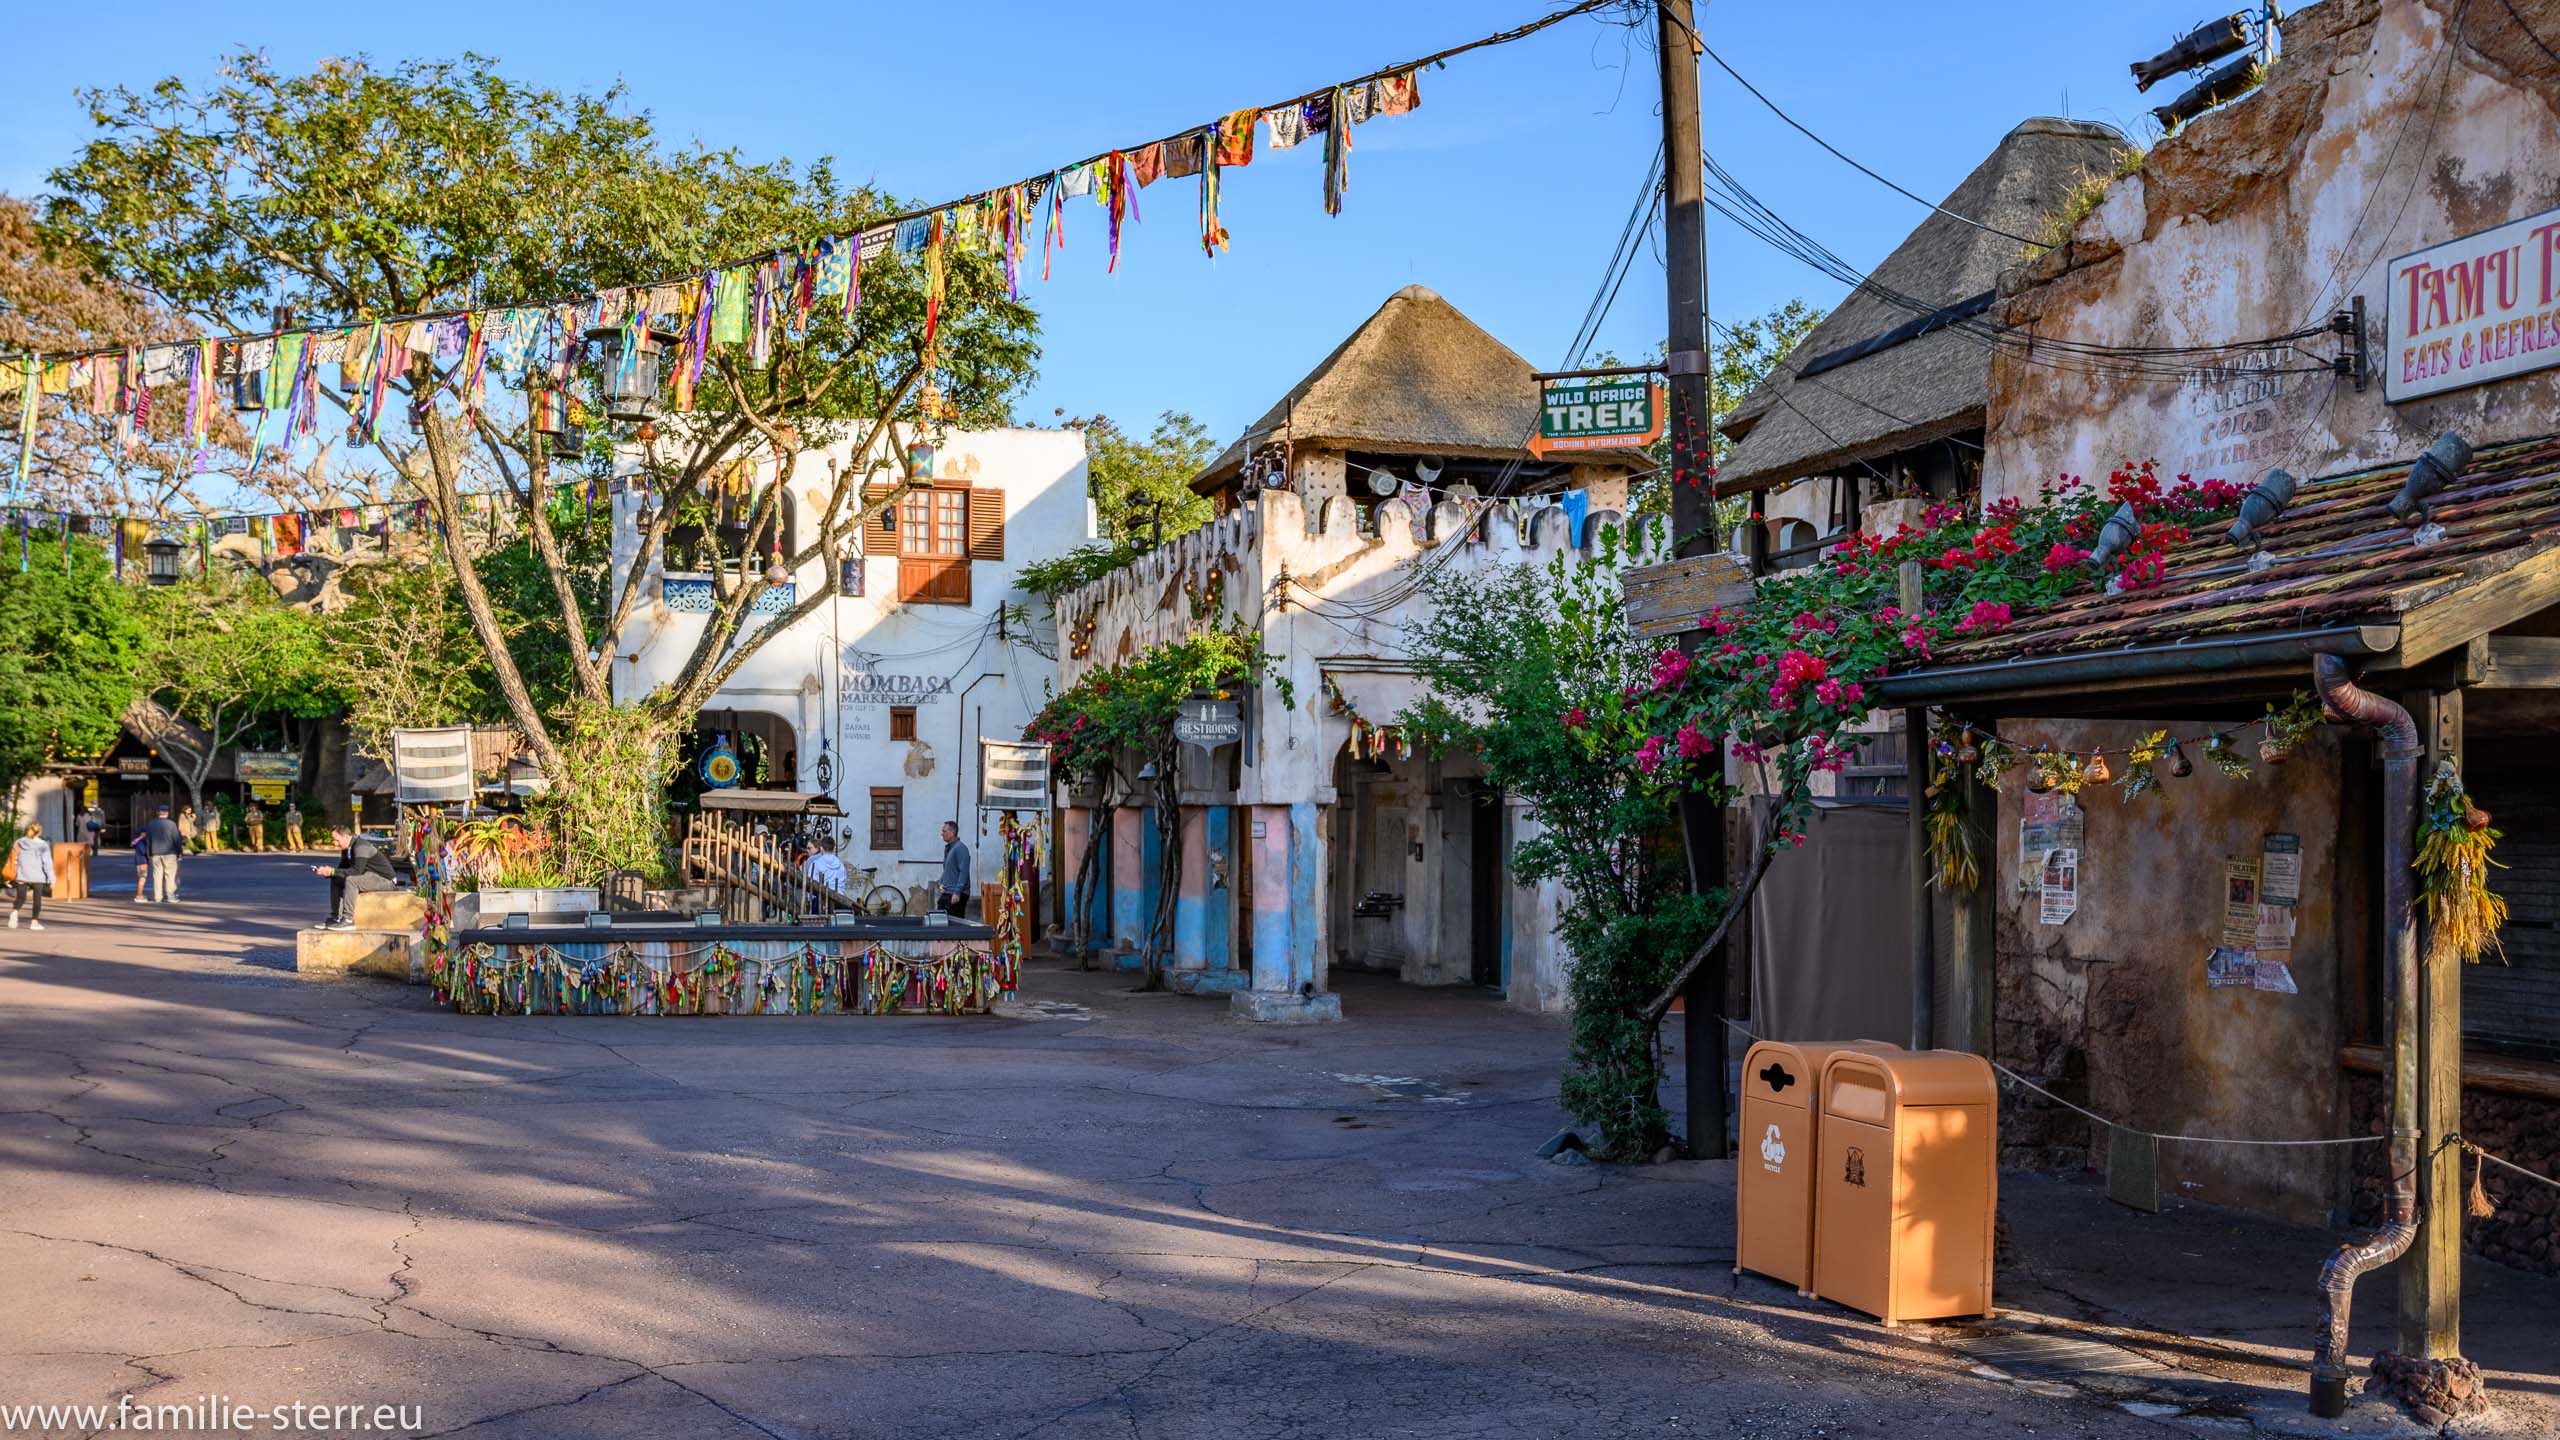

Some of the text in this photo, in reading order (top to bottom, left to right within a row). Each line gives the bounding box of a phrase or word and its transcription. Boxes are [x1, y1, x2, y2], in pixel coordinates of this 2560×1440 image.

[2399, 244, 2522, 339] TAMU
[2403, 337, 2452, 383] EATS
[2459, 331, 2475, 369] &
[1545, 387, 1646, 406] WILD AFRICA
[1546, 401, 1645, 431] TREK
[2201, 409, 2272, 445] COLD
[1588, 436, 1642, 448] INFORMATION
[1660, 590, 1713, 610] OFFICE
[840, 674, 955, 694] MOMBASA
[840, 692, 939, 705] MARKETPLACE
[1180, 721, 1238, 735] RESTROOMS
